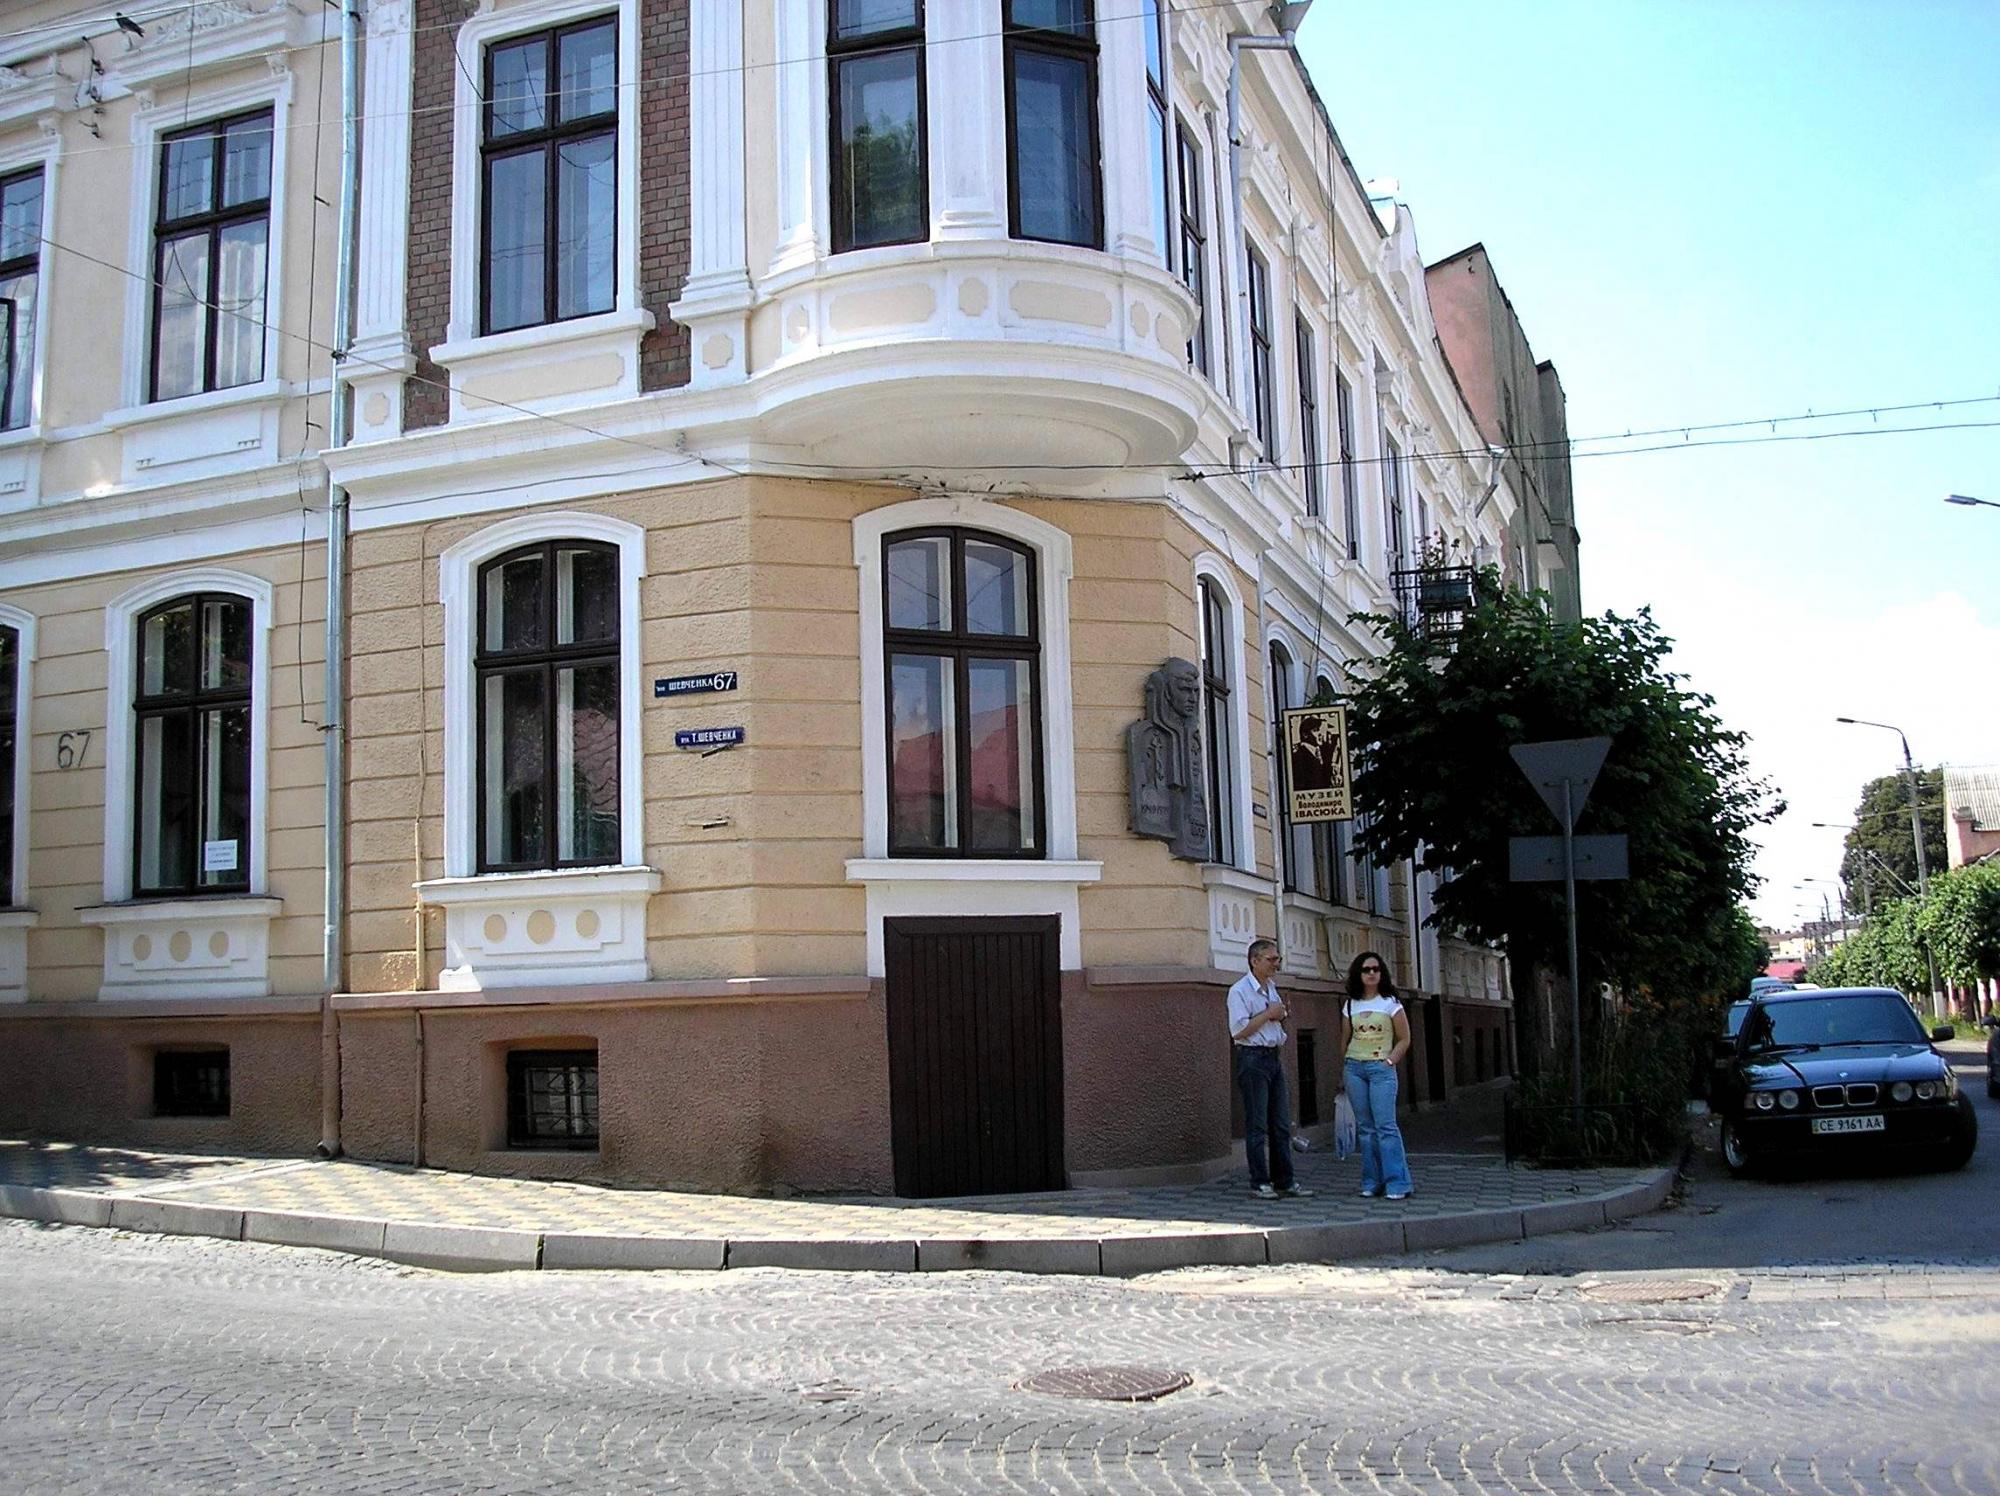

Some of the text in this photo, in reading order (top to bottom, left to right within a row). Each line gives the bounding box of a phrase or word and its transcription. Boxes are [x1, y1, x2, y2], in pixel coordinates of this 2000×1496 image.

[669, 673, 734, 691] ШЕВЧЕНКА 67
[58, 731, 91, 769] 67
[1296, 790, 1344, 800] МУЗЕЙ
[1295, 807, 1346, 818] ІВАСЮКА
[1820, 1117, 1882, 1131] CE 9161 AA
